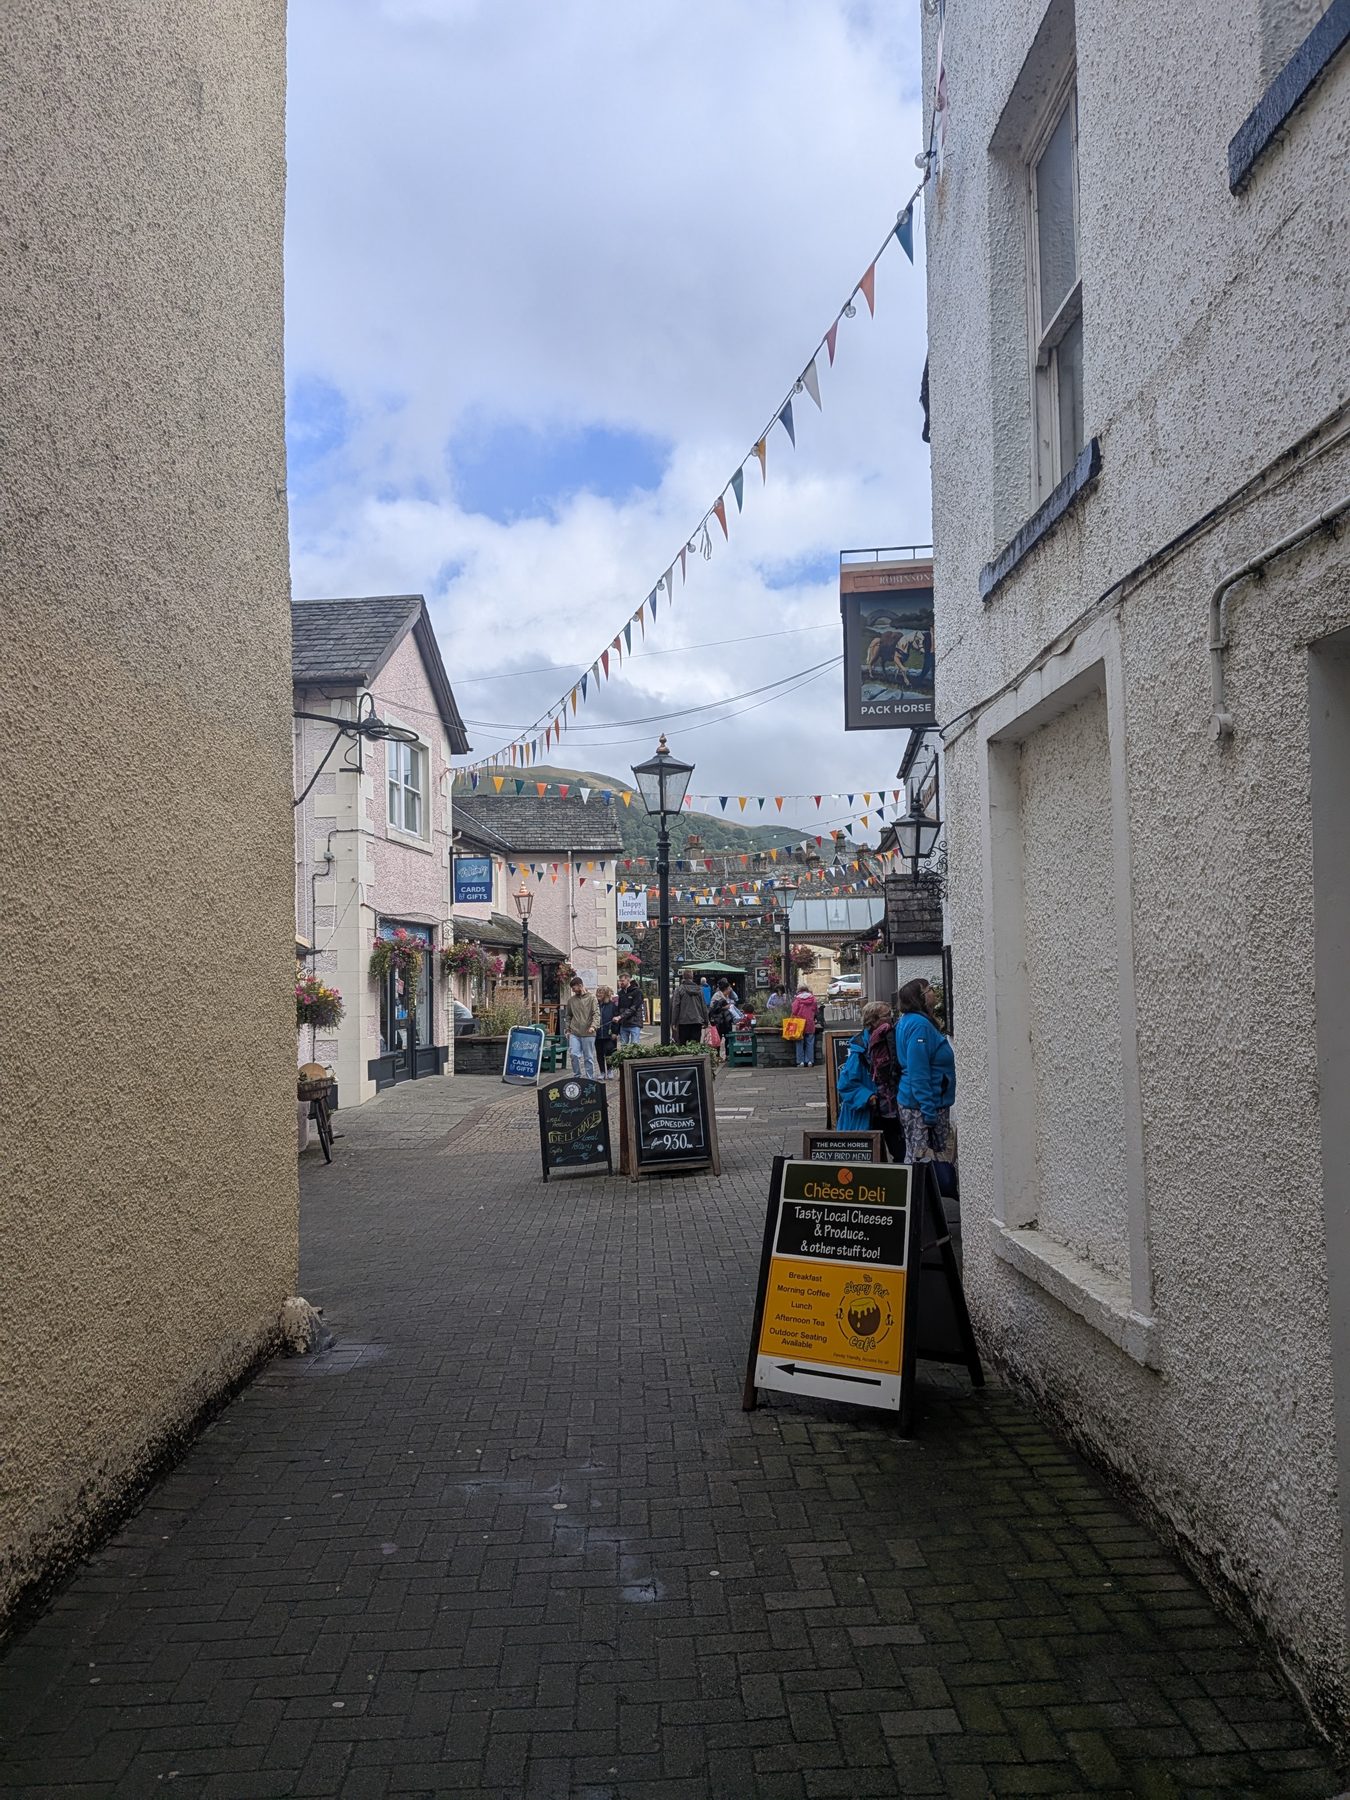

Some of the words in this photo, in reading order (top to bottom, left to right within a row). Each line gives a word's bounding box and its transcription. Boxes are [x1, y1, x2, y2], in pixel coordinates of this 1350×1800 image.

[880, 573, 933, 584] ROBINSON
[861, 706, 891, 714] PACK
[894, 704, 932, 713] HORSE
[622, 900, 641, 908] Happy
[512, 1059, 534, 1067] CARDS
[645, 1076, 692, 1102] Quiz
[654, 1102, 687, 1114] NIGHT
[650, 1120, 695, 1129] WEDNESDAYS
[551, 1132, 573, 1142] DELI
[812, 1152, 832, 1160] EARLY
[834, 1152, 850, 1160] BIRD
[852, 1152, 872, 1160] MENU
[804, 1182, 854, 1200] Cheese
[858, 1186, 886, 1202] Deli
[794, 1206, 822, 1223] Tasty
[824, 1208, 849, 1222] Local
[852, 1210, 893, 1226] Cheeses
[814, 1224, 822, 1236] &
[824, 1224, 870, 1240] Produce..
[800, 1240, 808, 1252] &
[810, 1242, 836, 1254] other
[836, 1245, 862, 1256] stuff
[862, 1247, 880, 1258] too!
[788, 1272, 822, 1282] Breakfast
[777, 1284, 804, 1296] Morning
[807, 1288, 830, 1298] Coffee
[844, 1281, 871, 1296] Honey
[873, 1282, 890, 1298] Pot
[791, 1301, 812, 1310] Lunch
[775, 1314, 810, 1324] Afternoon
[813, 1318, 825, 1326] Tea
[770, 1328, 799, 1338] Outdoor
[800, 1332, 828, 1343] Seating
[781, 1338, 813, 1349] Available
[849, 1336, 876, 1352] Café
